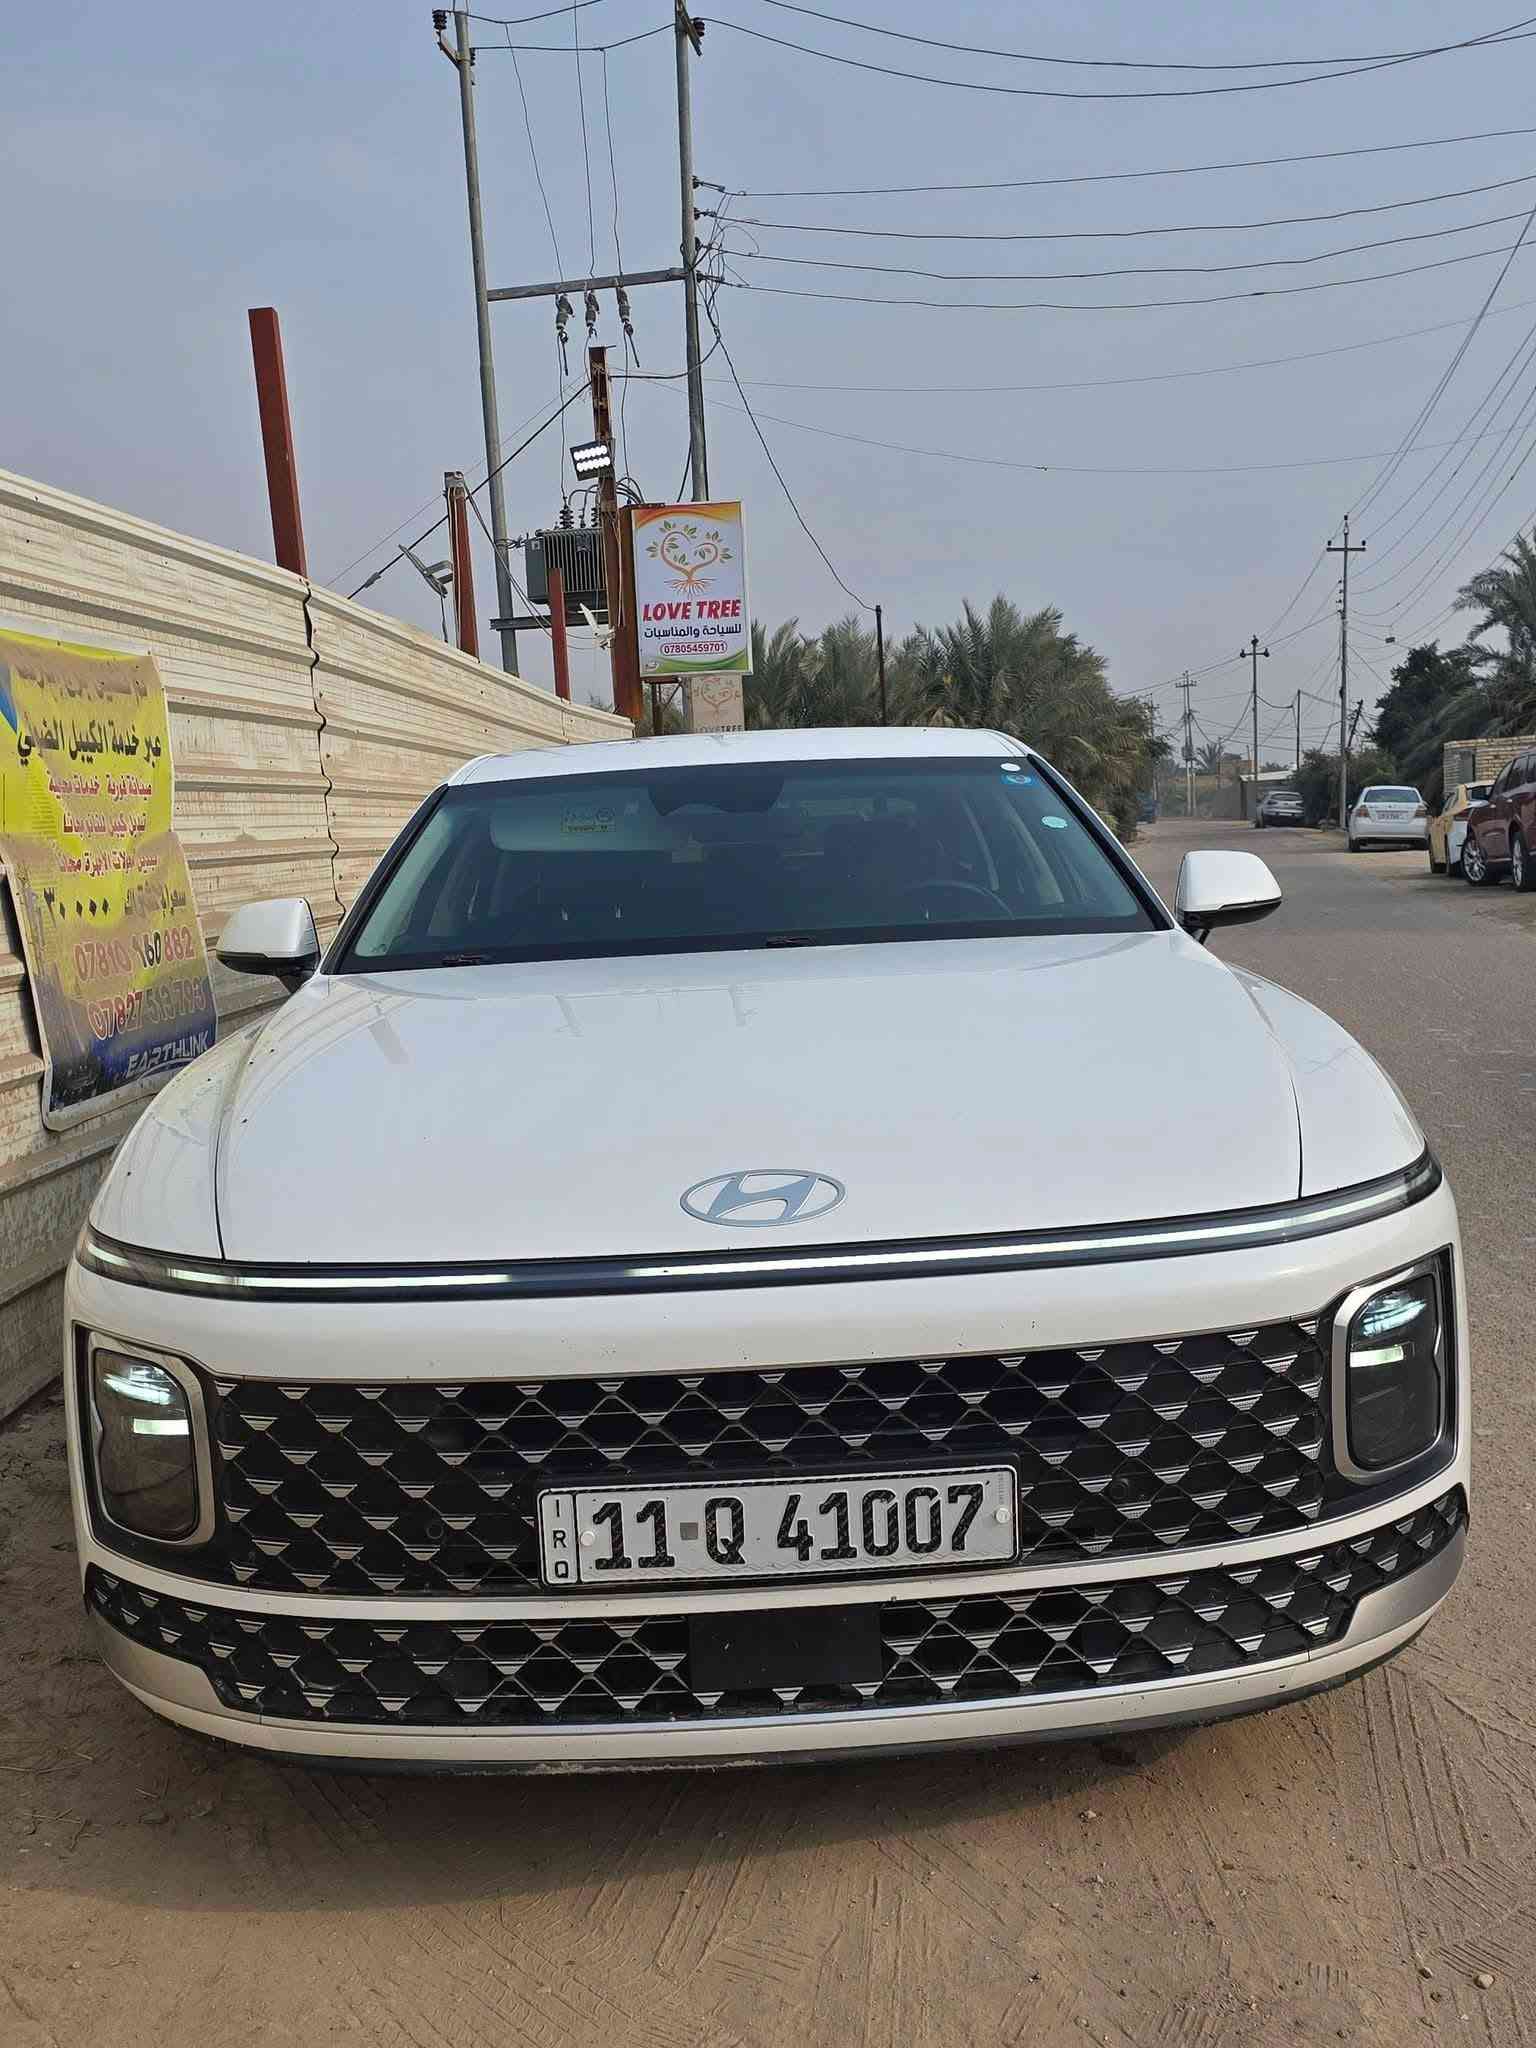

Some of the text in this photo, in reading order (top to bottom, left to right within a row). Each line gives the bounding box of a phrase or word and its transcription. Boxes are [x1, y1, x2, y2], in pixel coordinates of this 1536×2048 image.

[643, 598, 742, 622] LOVE TREE
[644, 623, 742, 639] للسياحة والمناسبات
[663, 643, 726, 654] 07805459701
[69, 719, 109, 765] الكيبل
[108, 720, 139, 756] خدمة
[143, 735, 161, 768] عبر
[127, 1031, 209, 1078] EARTHLINK
[592, 1499, 676, 1571] 11
[704, 1496, 747, 1566] Q
[775, 1480, 987, 1563] 41007
